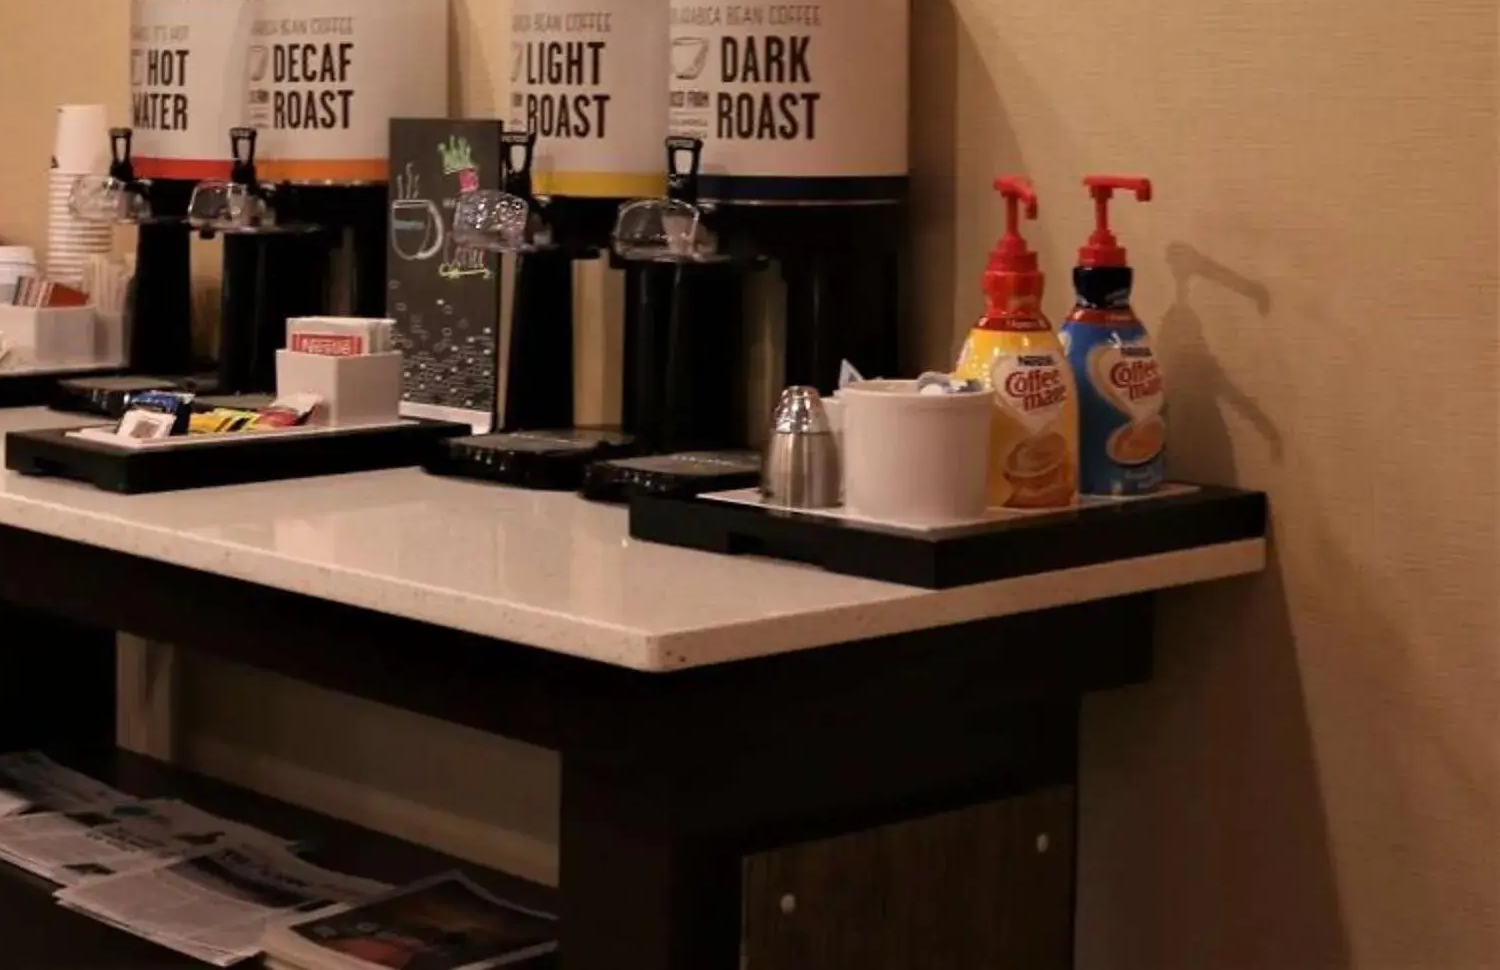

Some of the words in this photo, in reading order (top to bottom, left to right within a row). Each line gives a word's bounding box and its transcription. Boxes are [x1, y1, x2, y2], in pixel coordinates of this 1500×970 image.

[769, 4, 822, 26] COFFEE
[147, 48, 190, 87] HOT
[273, 42, 354, 83] DECAF
[527, 41, 606, 85] LIGHT
[721, 35, 812, 84] DARK
[132, 93, 189, 131] WATER
[273, 90, 355, 130] ROAST
[527, 93, 612, 139] ROAST
[717, 91, 822, 140] ROAST
[1005, 369, 1061, 399] Coffee
